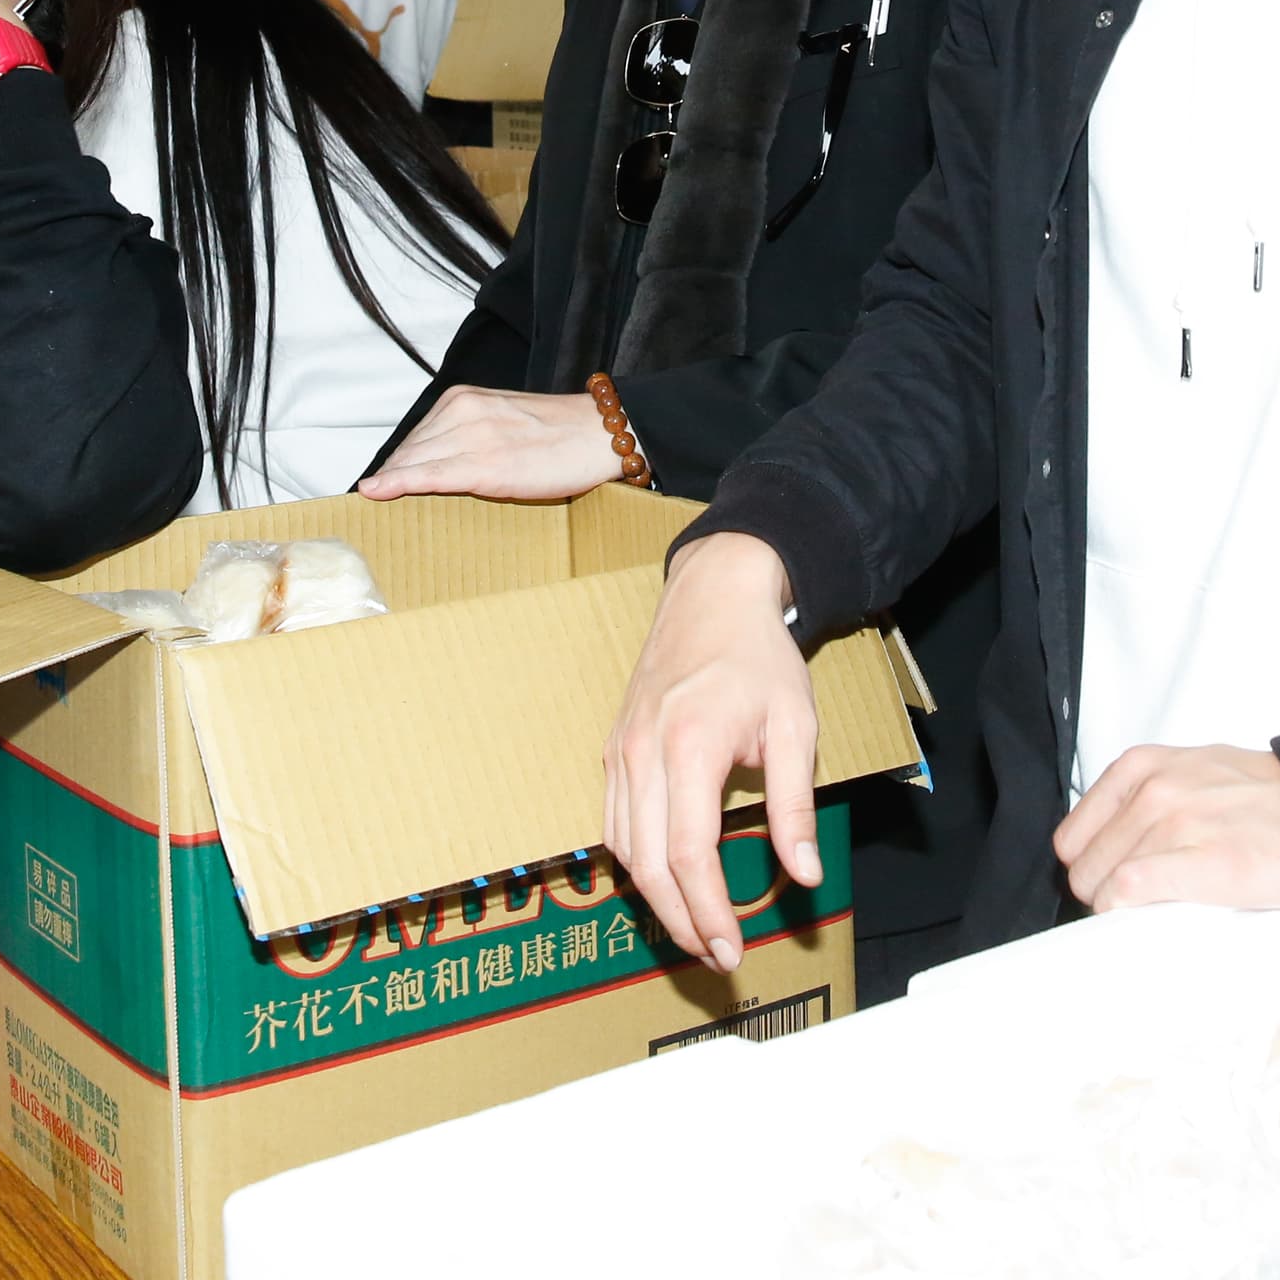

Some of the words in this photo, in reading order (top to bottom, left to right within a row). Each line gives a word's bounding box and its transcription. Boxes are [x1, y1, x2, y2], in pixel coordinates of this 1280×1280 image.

[243, 912, 671, 1055] 芥花不飽和健康調合
